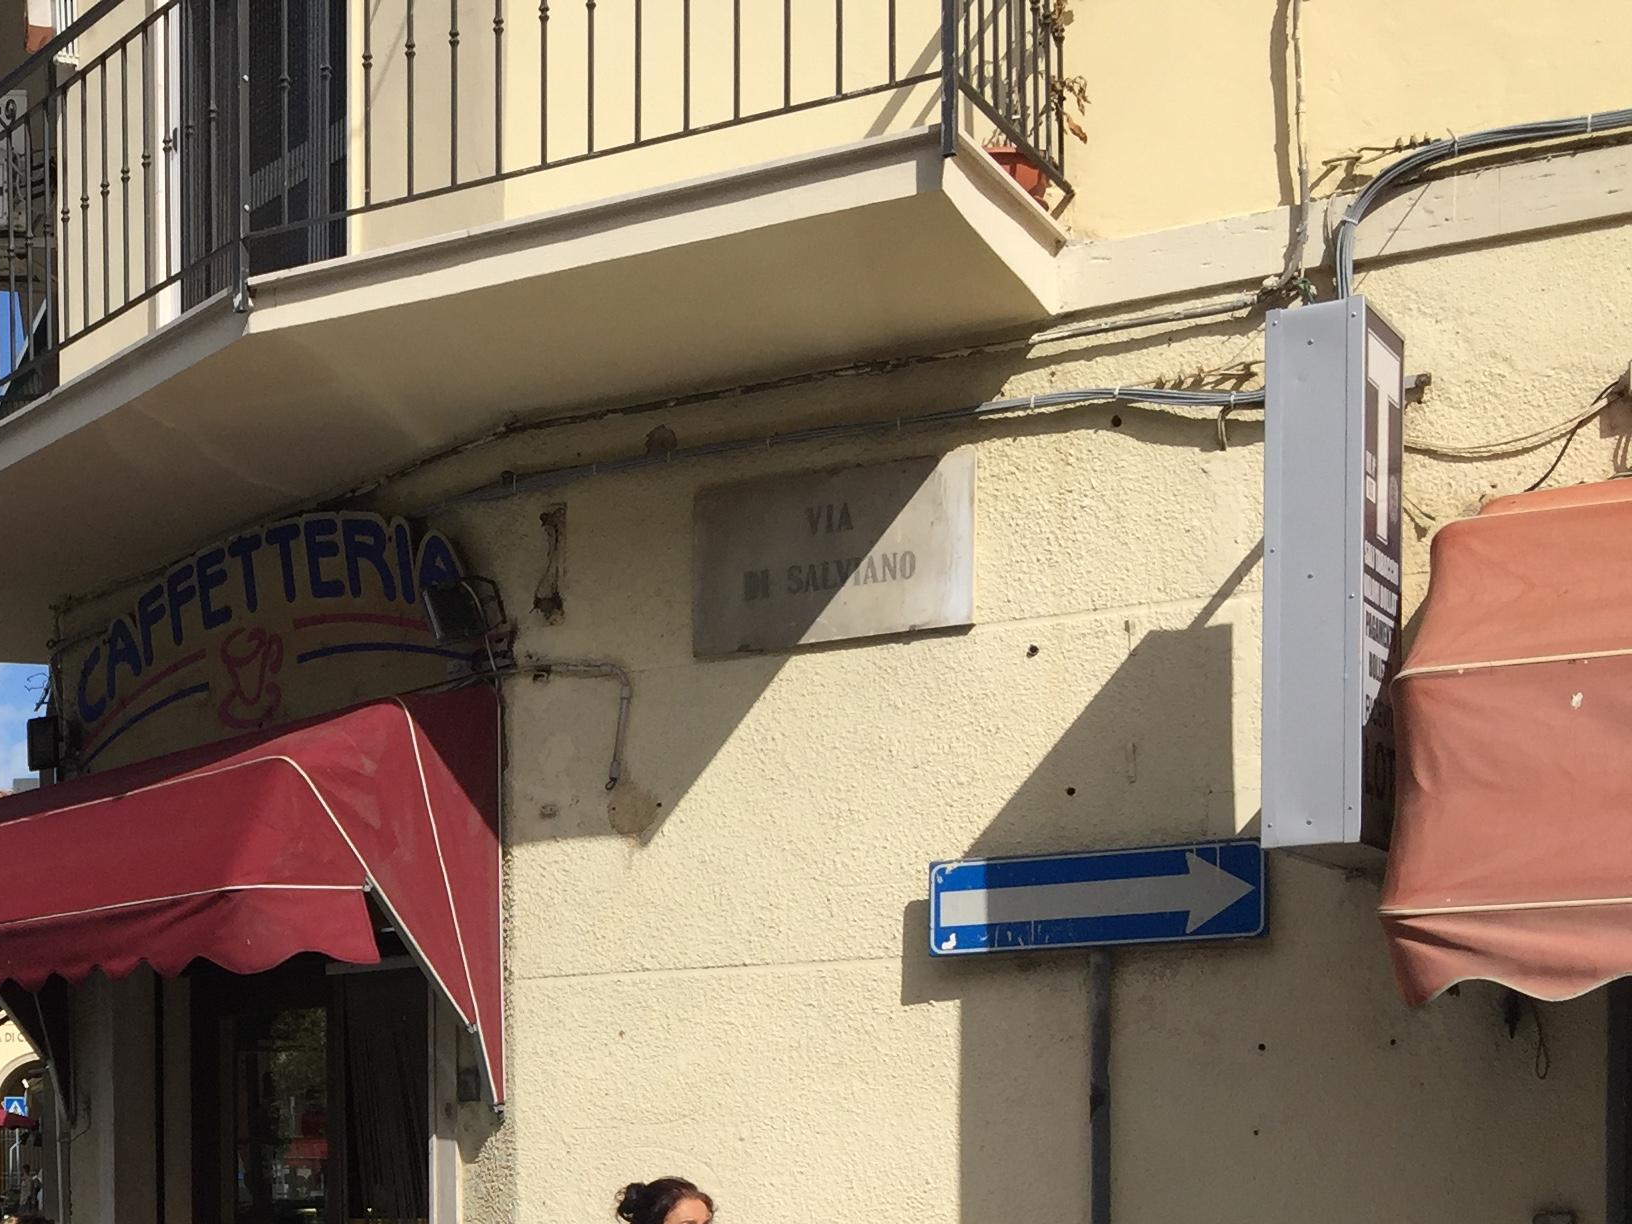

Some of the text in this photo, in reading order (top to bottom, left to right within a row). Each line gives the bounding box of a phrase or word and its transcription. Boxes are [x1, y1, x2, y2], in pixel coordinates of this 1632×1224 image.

[805, 503, 855, 536] VIA
[742, 550, 917, 602] DI SALVIANO
[77, 517, 464, 722] CAFFETTERIA
